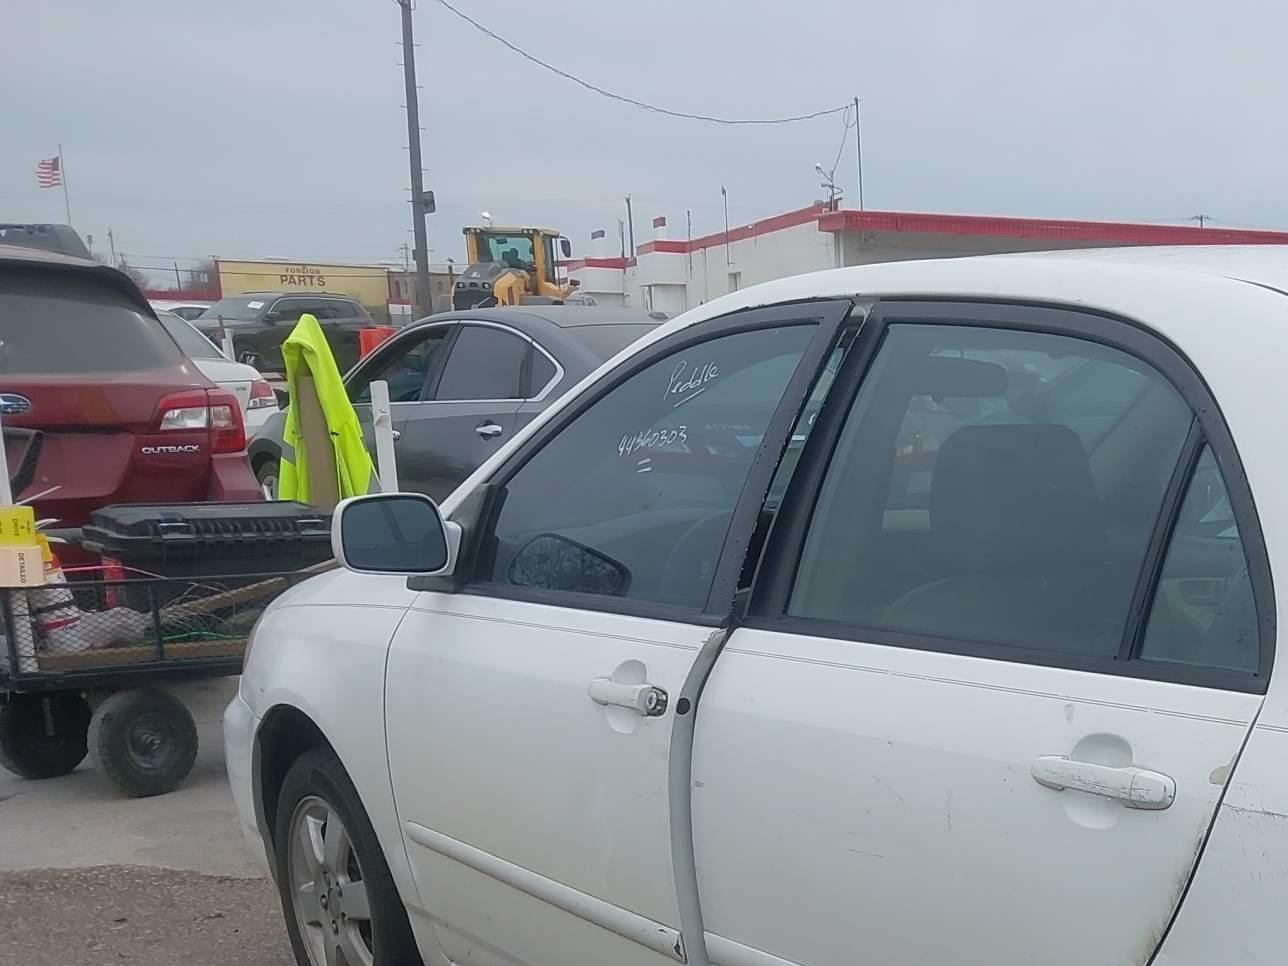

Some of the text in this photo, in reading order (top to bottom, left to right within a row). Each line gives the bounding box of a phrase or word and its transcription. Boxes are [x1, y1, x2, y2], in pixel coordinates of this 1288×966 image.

[280, 275, 326, 287] PARTS
[141, 444, 201, 455] OUTBACK
[618, 425, 688, 457] 44360303
[18, 552, 27, 584] DETAILED
